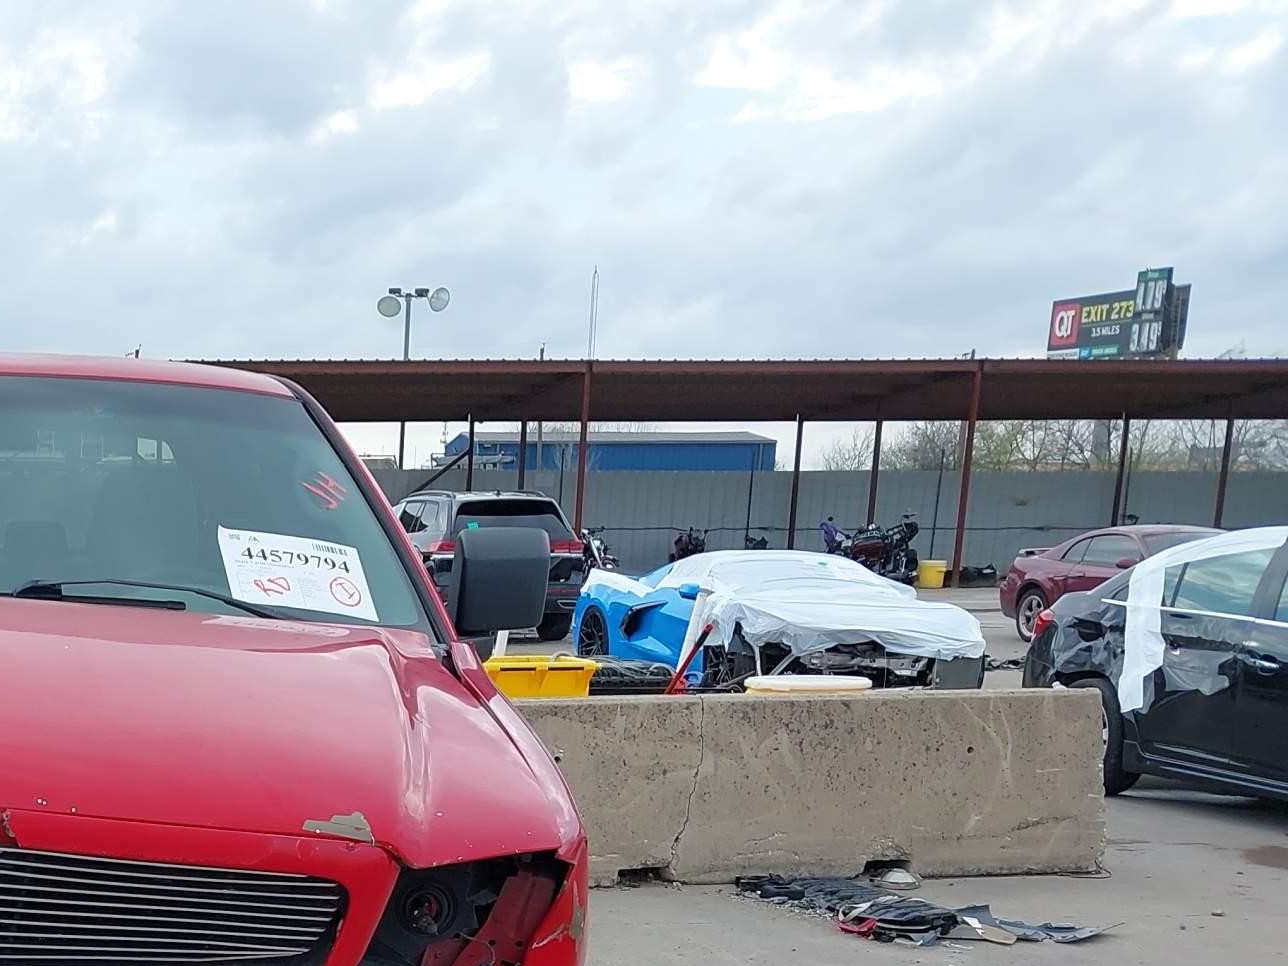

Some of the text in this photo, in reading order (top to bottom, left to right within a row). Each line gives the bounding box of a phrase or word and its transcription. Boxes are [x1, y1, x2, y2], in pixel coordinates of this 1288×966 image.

[1055, 310, 1075, 337] QT
[1081, 300, 1135, 323] EXIT 273
[1101, 325, 1120, 336] MILES
[241, 546, 351, 574] 44579794
